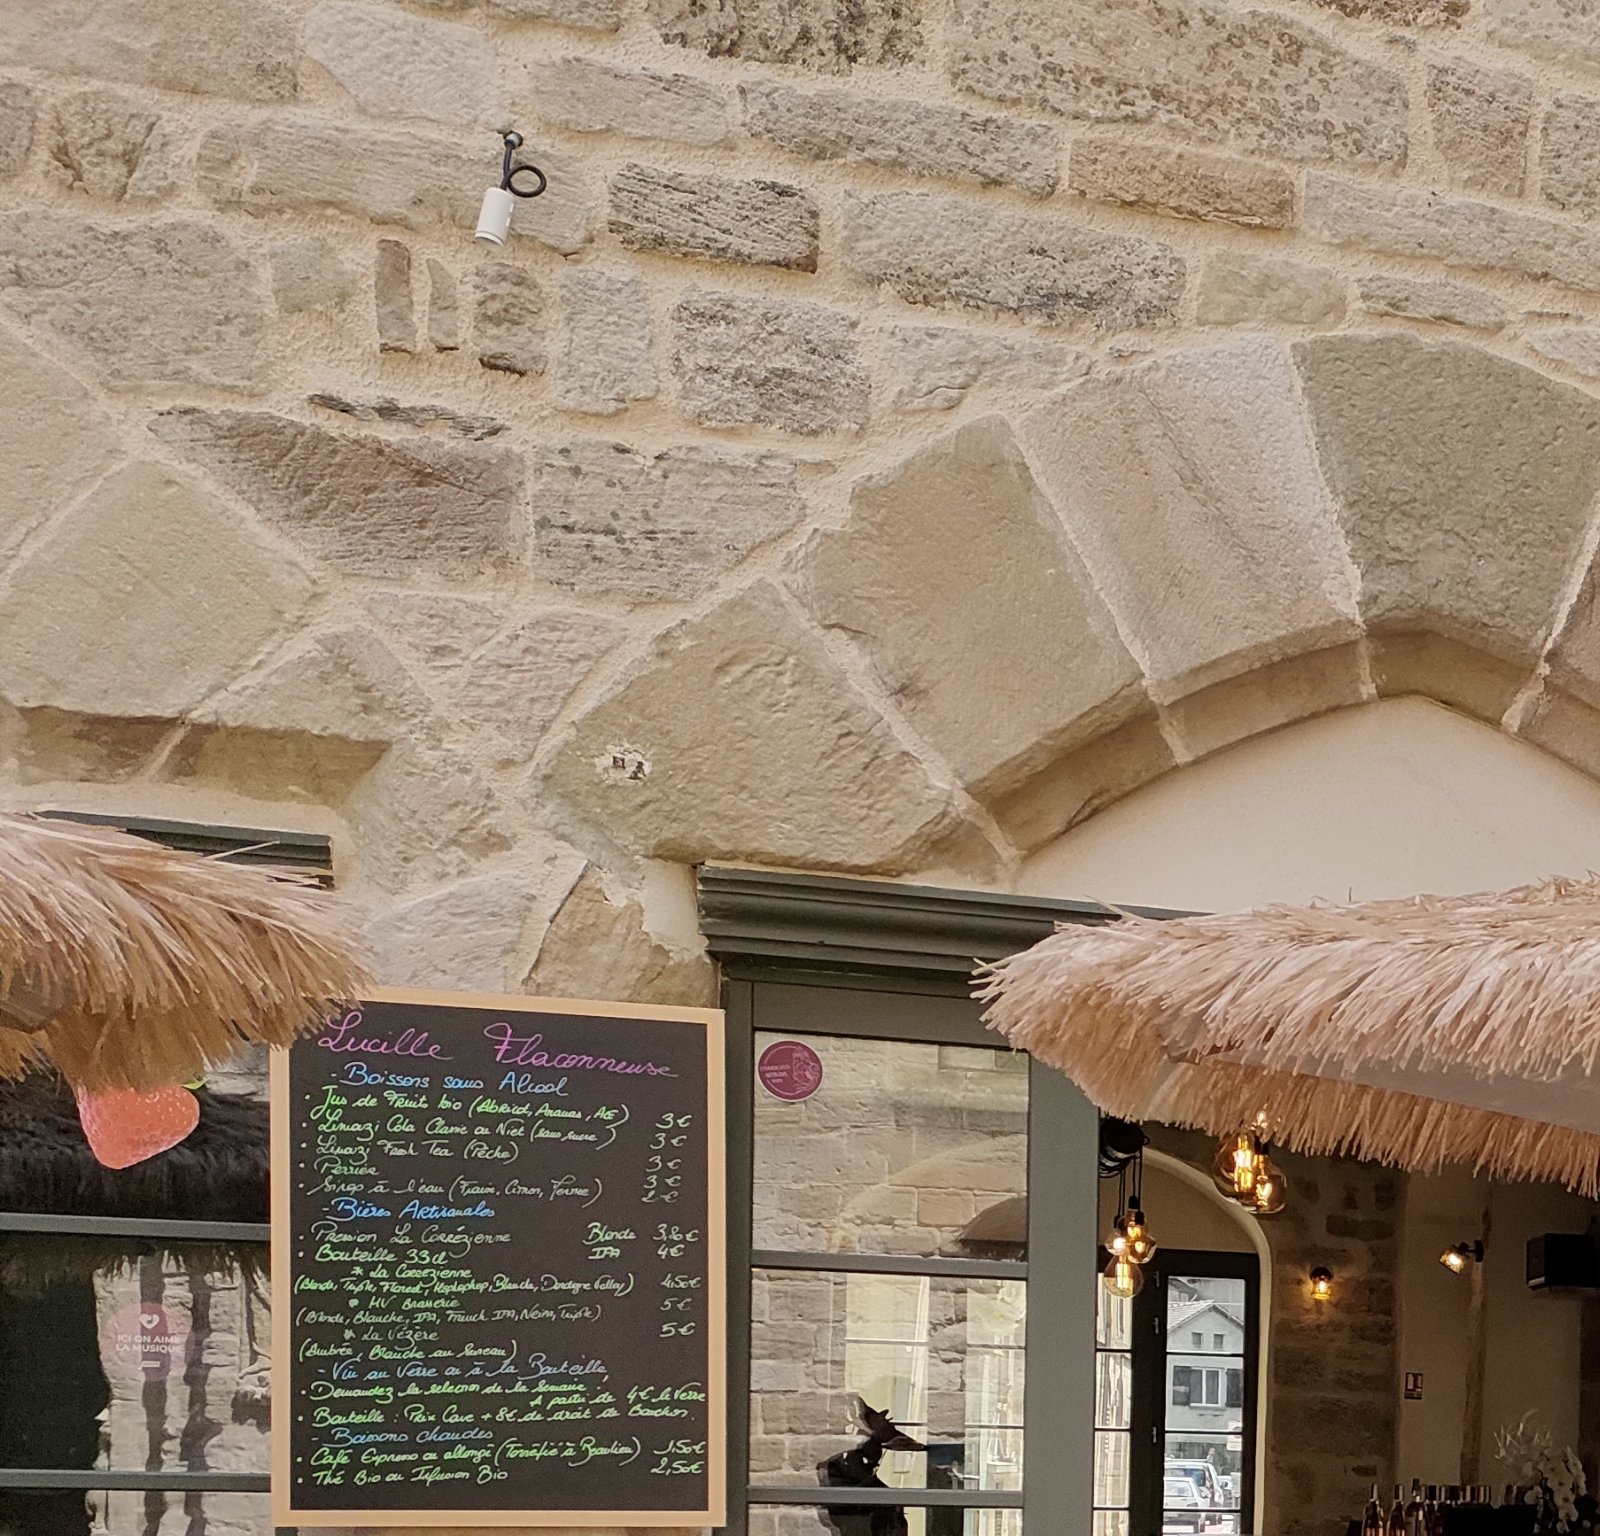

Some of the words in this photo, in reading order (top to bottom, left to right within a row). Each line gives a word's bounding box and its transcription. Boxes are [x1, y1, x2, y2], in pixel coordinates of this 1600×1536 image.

[318, 1011, 453, 1060] Lucille
[339, 1062, 429, 1088] Boissons
[498, 1072, 568, 1096] Alcool
[310, 1085, 347, 1119] Jus
[352, 1094, 378, 1107] de
[438, 1094, 462, 1110] bio
[421, 1139, 454, 1156] Tea
[390, 1223, 413, 1244] La
[582, 1222, 637, 1245] Blonde
[314, 1243, 397, 1262] Bouteille
[588, 1247, 620, 1260] IPA
[361, 1326, 383, 1341] La
[132, 1345, 182, 1353] MUSIQUE
[309, 1381, 394, 1404] Demandez
[311, 1406, 385, 1427] Bouteille
[416, 1426, 493, 1443] chaudes
[310, 1447, 352, 1469] Café
[312, 1470, 345, 1486] Thé
[354, 1470, 381, 1485] Bio
[477, 1465, 508, 1484] Bio
